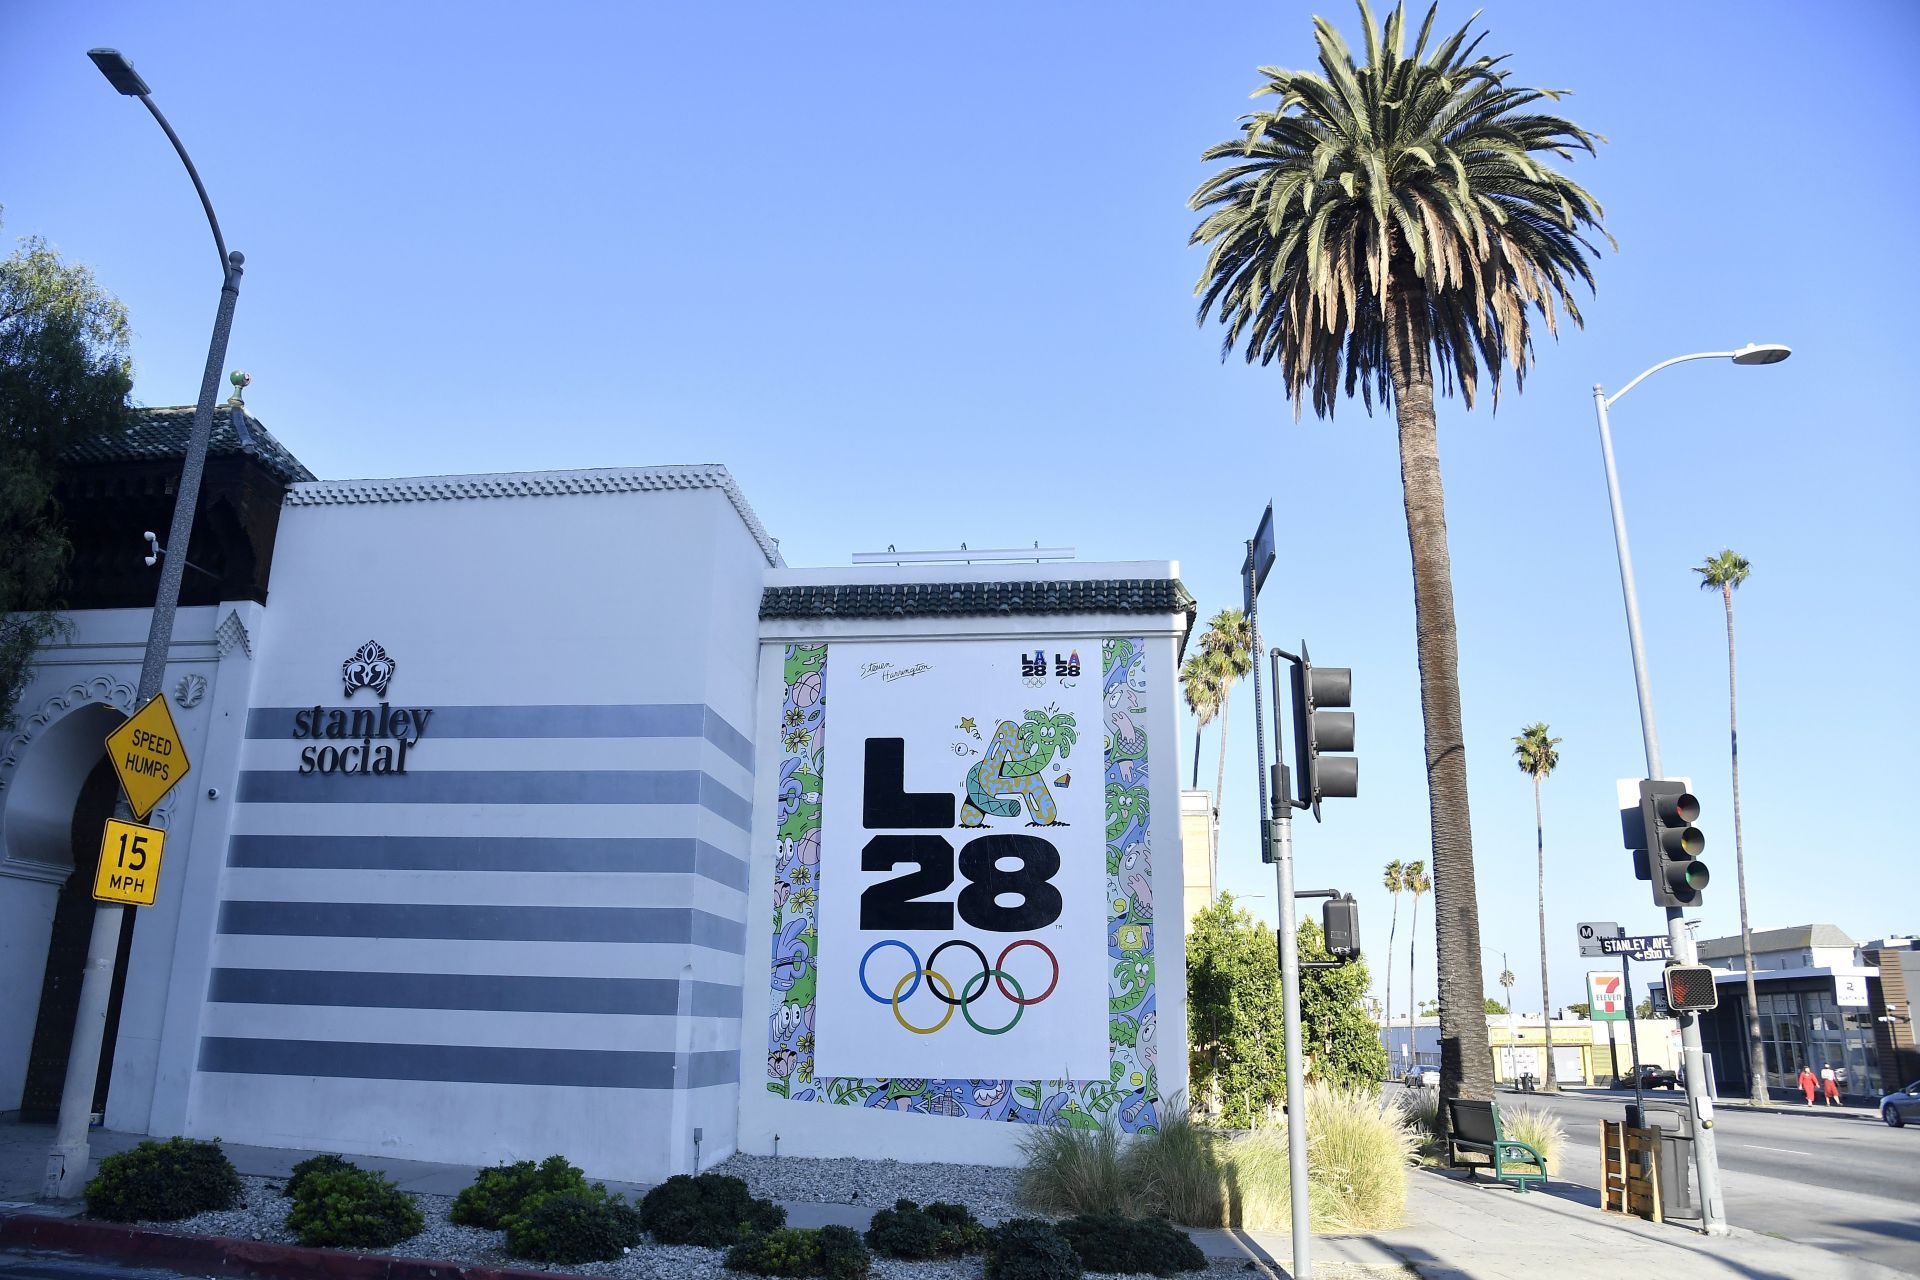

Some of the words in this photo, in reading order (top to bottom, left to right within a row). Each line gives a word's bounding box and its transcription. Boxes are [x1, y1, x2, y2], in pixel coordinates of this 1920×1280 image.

[1022, 650, 1047, 665] LA
[1022, 665, 1047, 677] 28
[1055, 665, 1080, 677] 28
[1056, 649, 1080, 666] LA
[293, 702, 433, 748] stanley
[132, 729, 172, 756] SPEED
[125, 752, 169, 781] HUMPS
[299, 738, 407, 776] social
[863, 720, 1057, 829] LA
[117, 833, 148, 871] 15
[109, 874, 145, 893] MPH
[860, 834, 1063, 932] 28
[1581, 927, 1592, 938] M
[1604, 939, 1646, 952] STANLEY
[1595, 976, 1620, 1013] 7
